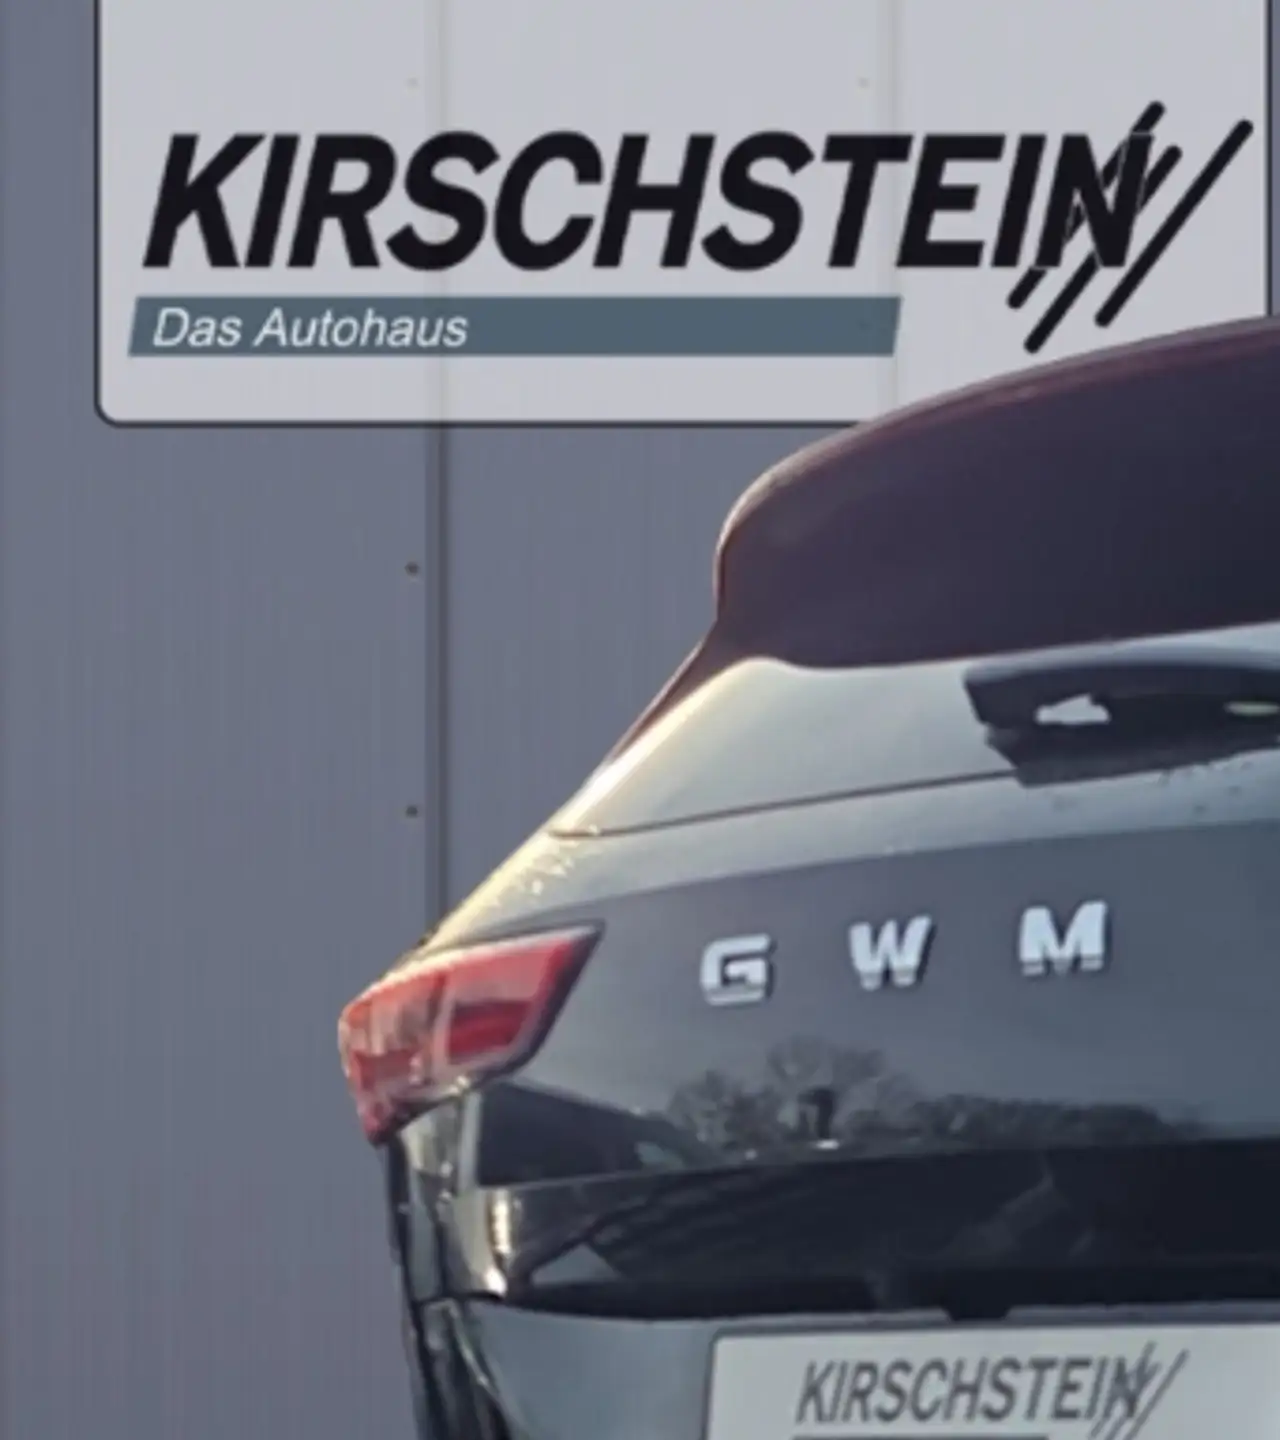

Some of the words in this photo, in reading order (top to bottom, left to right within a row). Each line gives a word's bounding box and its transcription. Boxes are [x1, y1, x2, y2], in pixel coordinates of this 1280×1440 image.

[141, 130, 1155, 270] KIRSCHSTEIN
[152, 307, 242, 347] Das
[252, 307, 469, 347] Autohaus
[795, 1356, 1144, 1424] KIRSCHSTEIN
